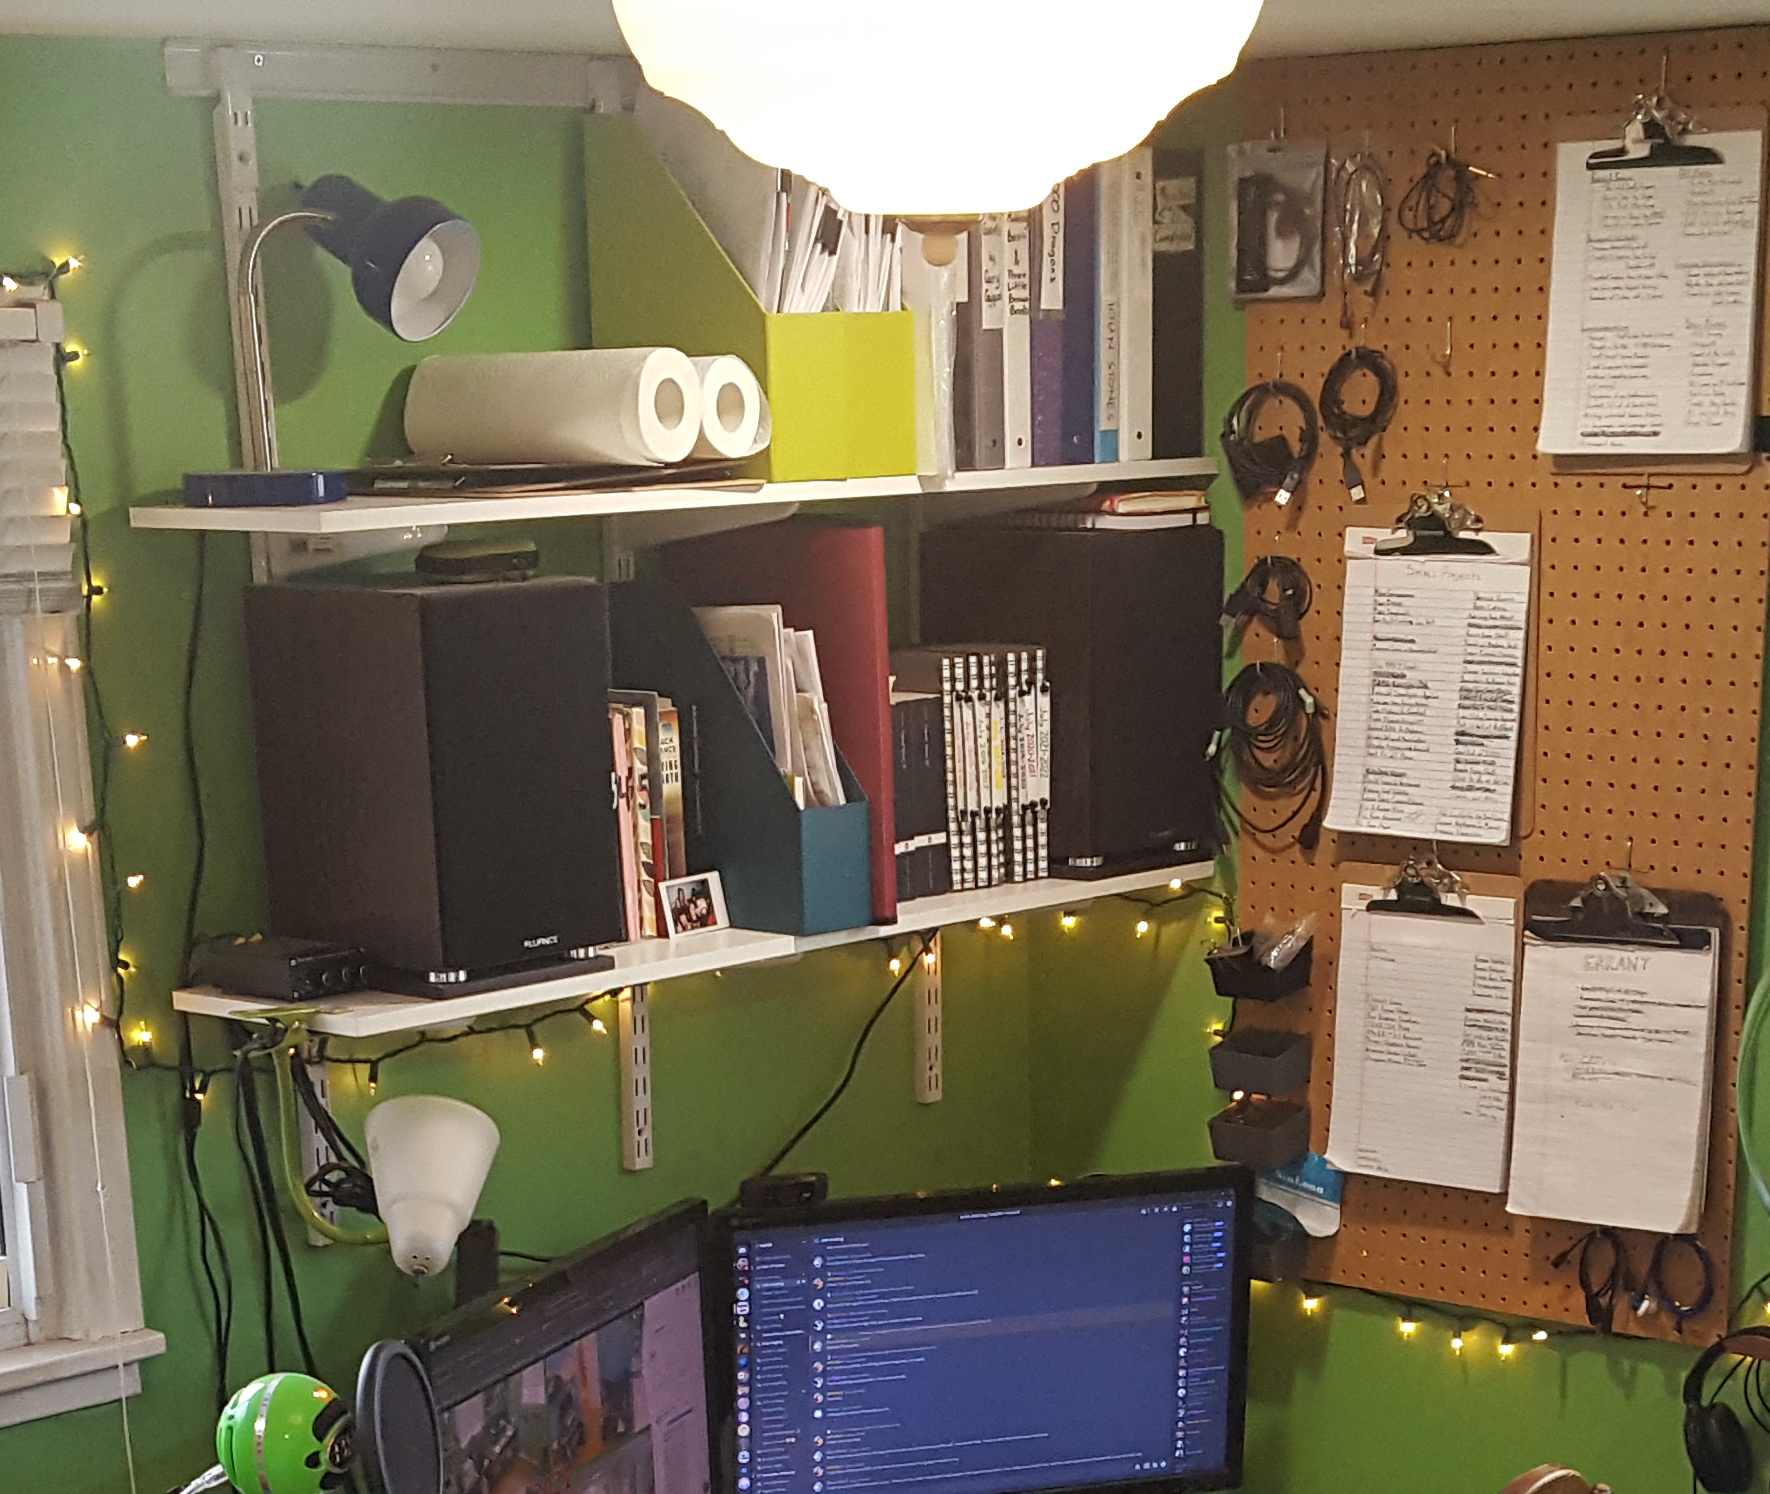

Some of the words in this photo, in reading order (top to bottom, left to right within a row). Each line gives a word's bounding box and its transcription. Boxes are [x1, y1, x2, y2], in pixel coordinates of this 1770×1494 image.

[1048, 221, 1061, 283] Dragons
[1106, 360, 1117, 421] STONES
[1040, 731, 1049, 778] 2021-2022
[1583, 955, 1652, 972] ERRANT
